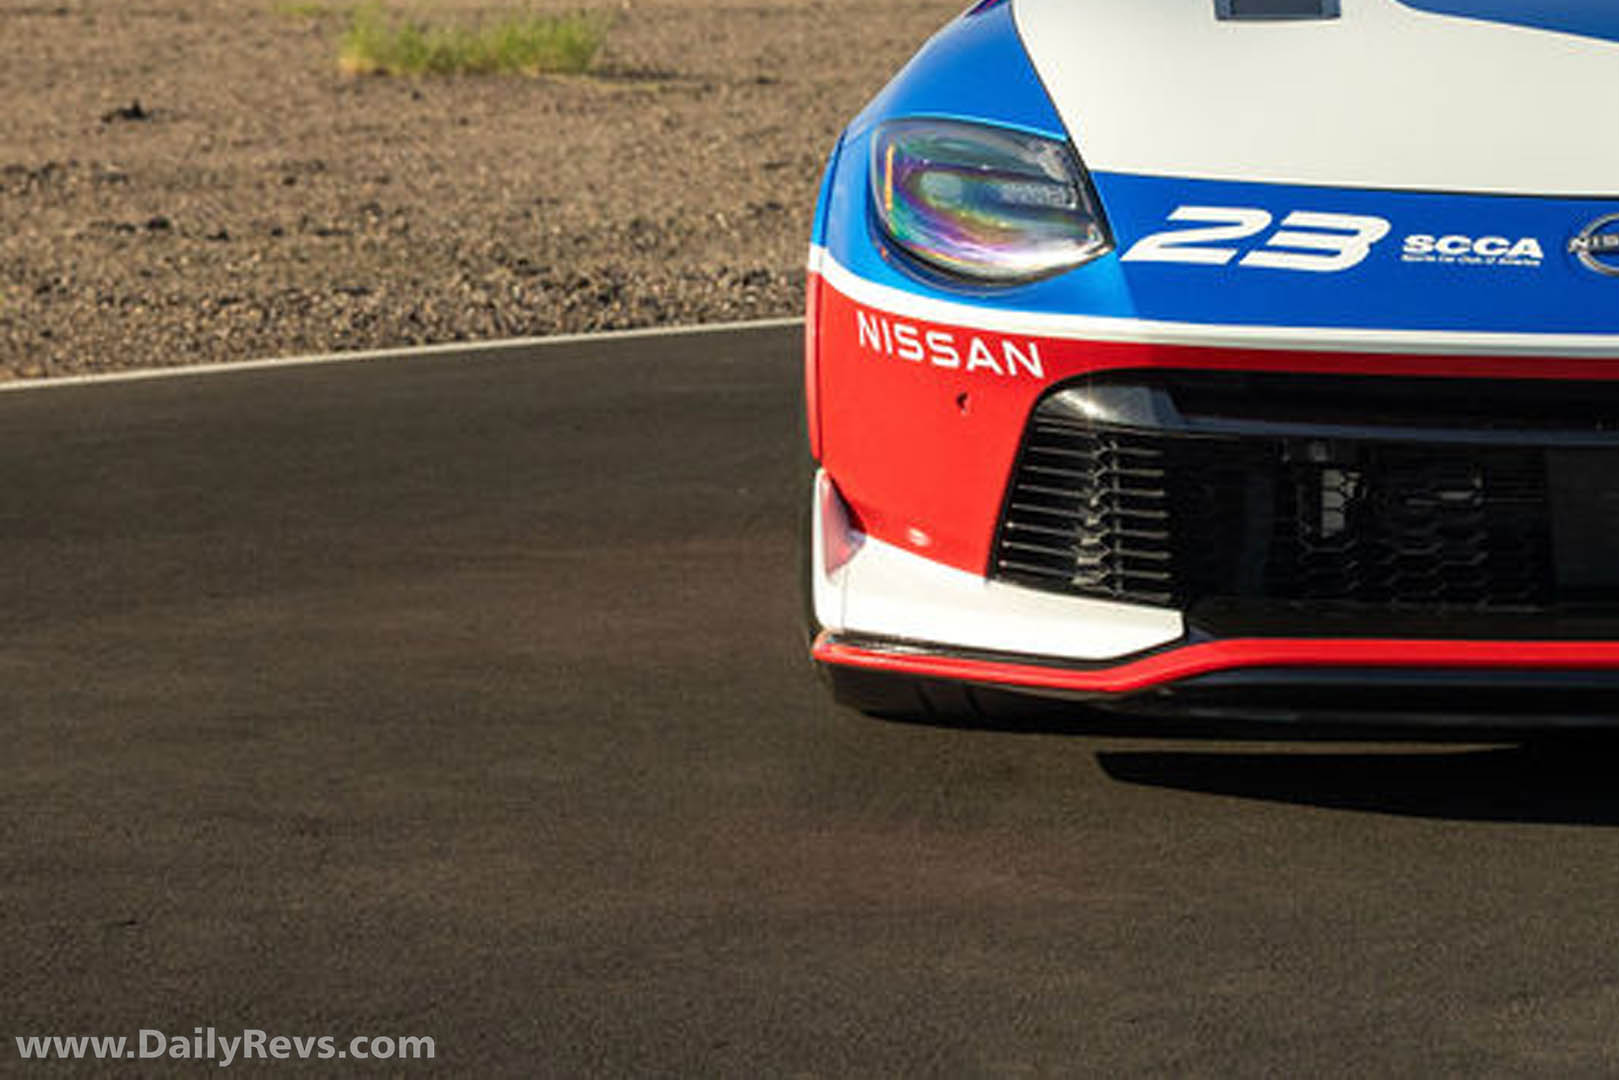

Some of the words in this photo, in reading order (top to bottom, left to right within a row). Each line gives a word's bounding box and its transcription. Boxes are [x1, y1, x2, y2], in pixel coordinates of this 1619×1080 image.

[1120, 206, 1392, 272] 23
[1403, 235, 1545, 259] SCCA
[856, 311, 1045, 379] NISSAN
